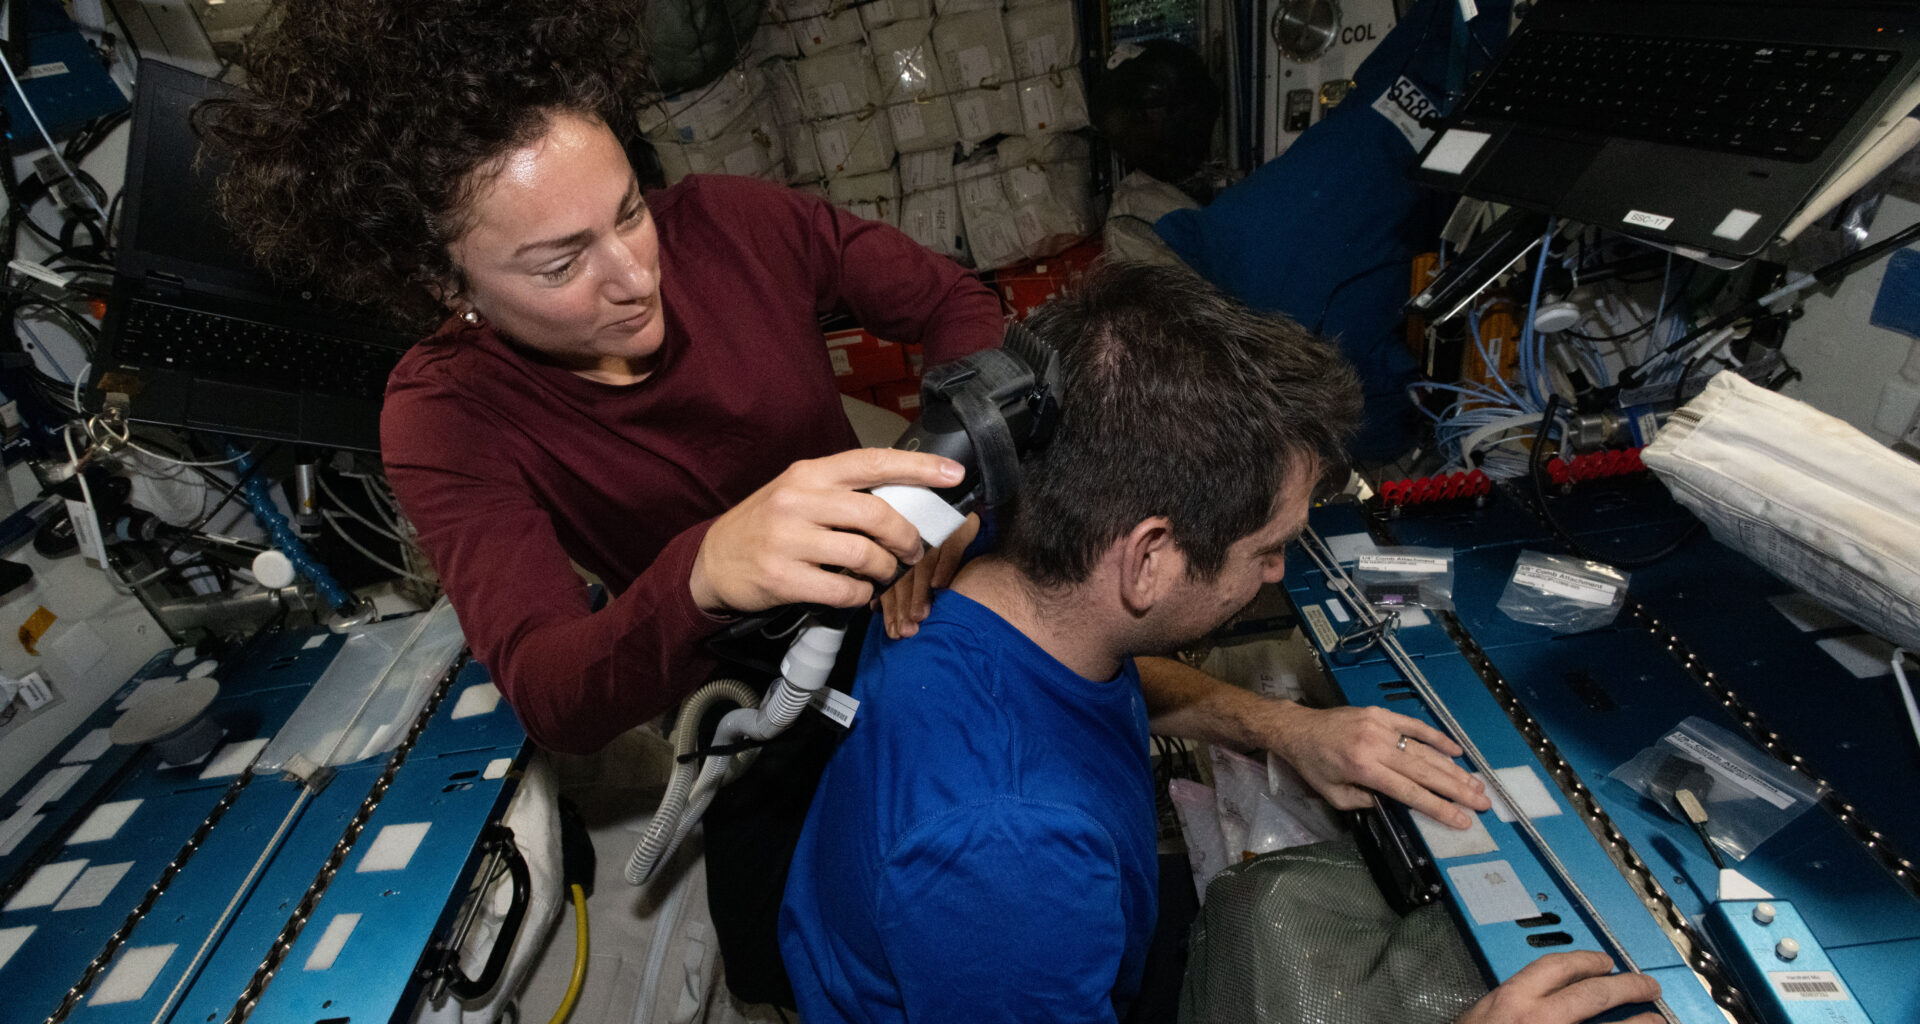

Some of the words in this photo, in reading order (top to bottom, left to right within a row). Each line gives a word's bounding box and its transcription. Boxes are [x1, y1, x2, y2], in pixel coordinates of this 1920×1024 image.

[1341, 24, 1376, 45] COL
[1631, 213, 1667, 226] SSC-17
[1535, 568, 1558, 577] Comb
[1559, 573, 1603, 589] Attachment
[1723, 760, 1779, 793] Attachment
